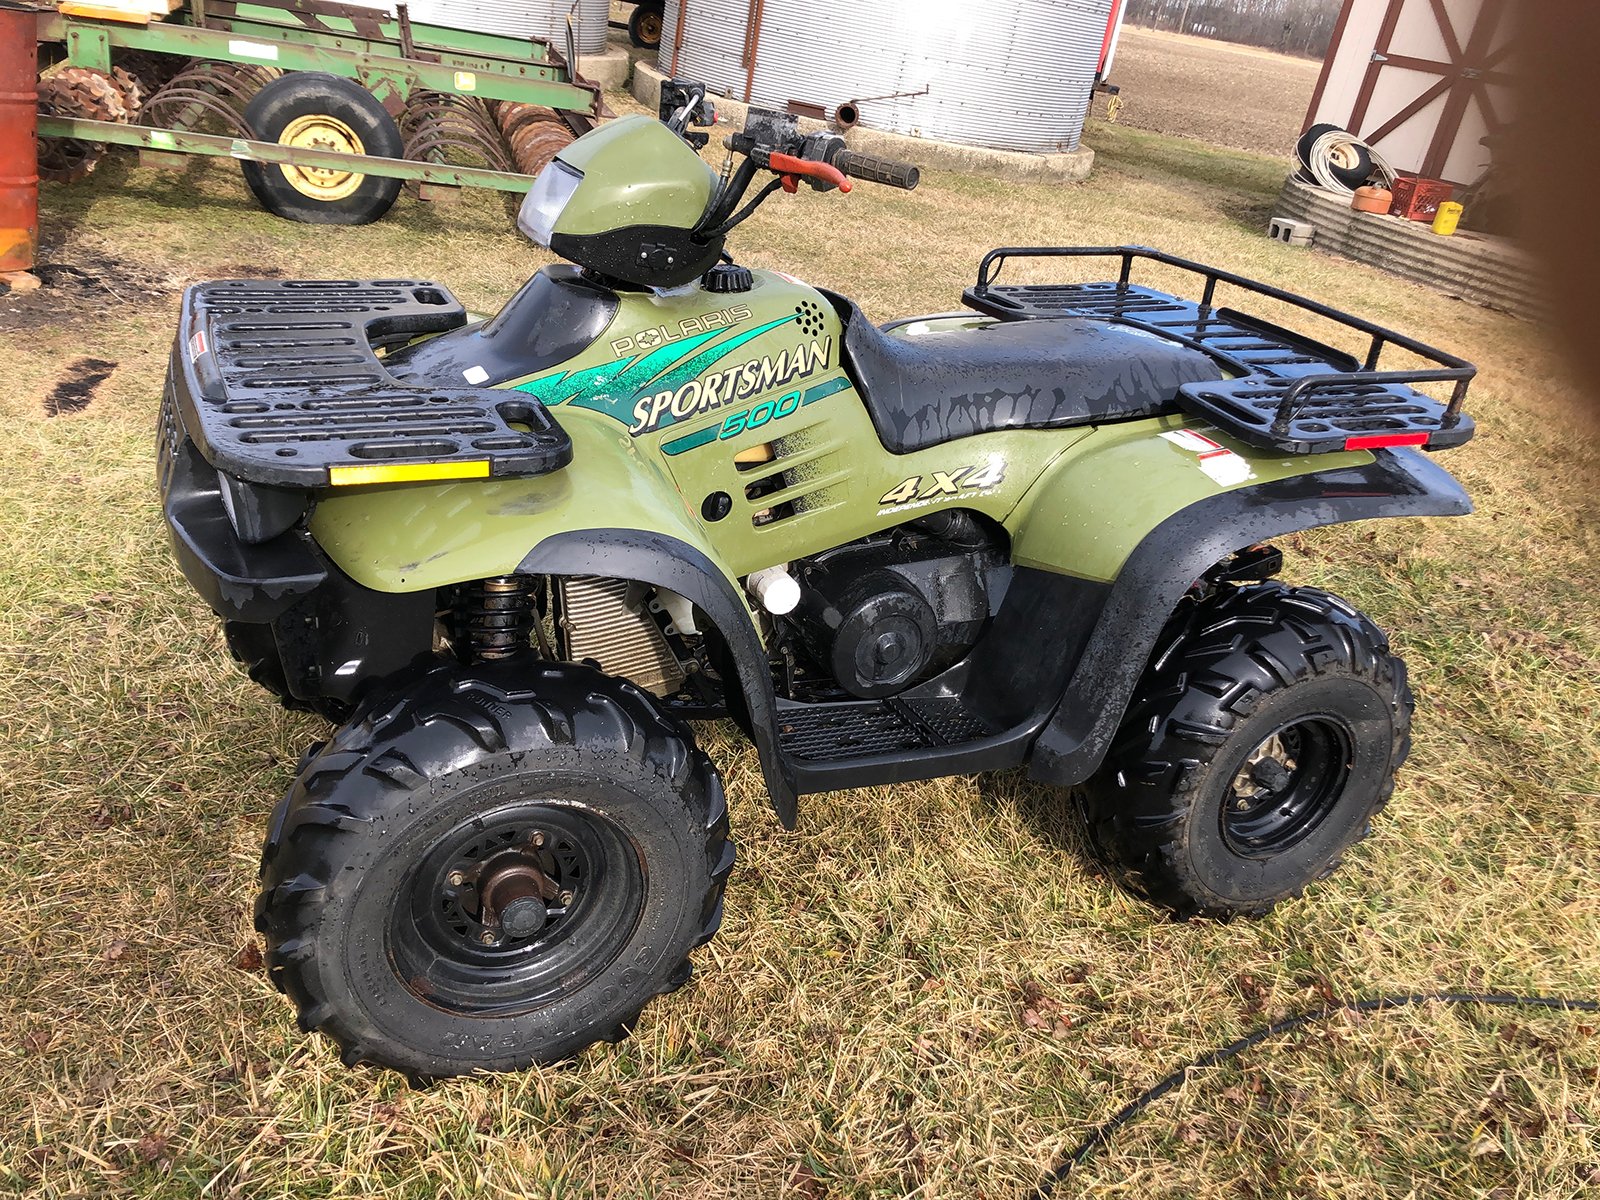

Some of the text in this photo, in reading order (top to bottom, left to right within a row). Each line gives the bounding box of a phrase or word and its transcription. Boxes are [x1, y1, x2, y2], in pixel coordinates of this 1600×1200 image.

[610, 304, 753, 358] POLARIS
[629, 335, 832, 437] SPORTSMAN
[719, 390, 801, 440] 500
